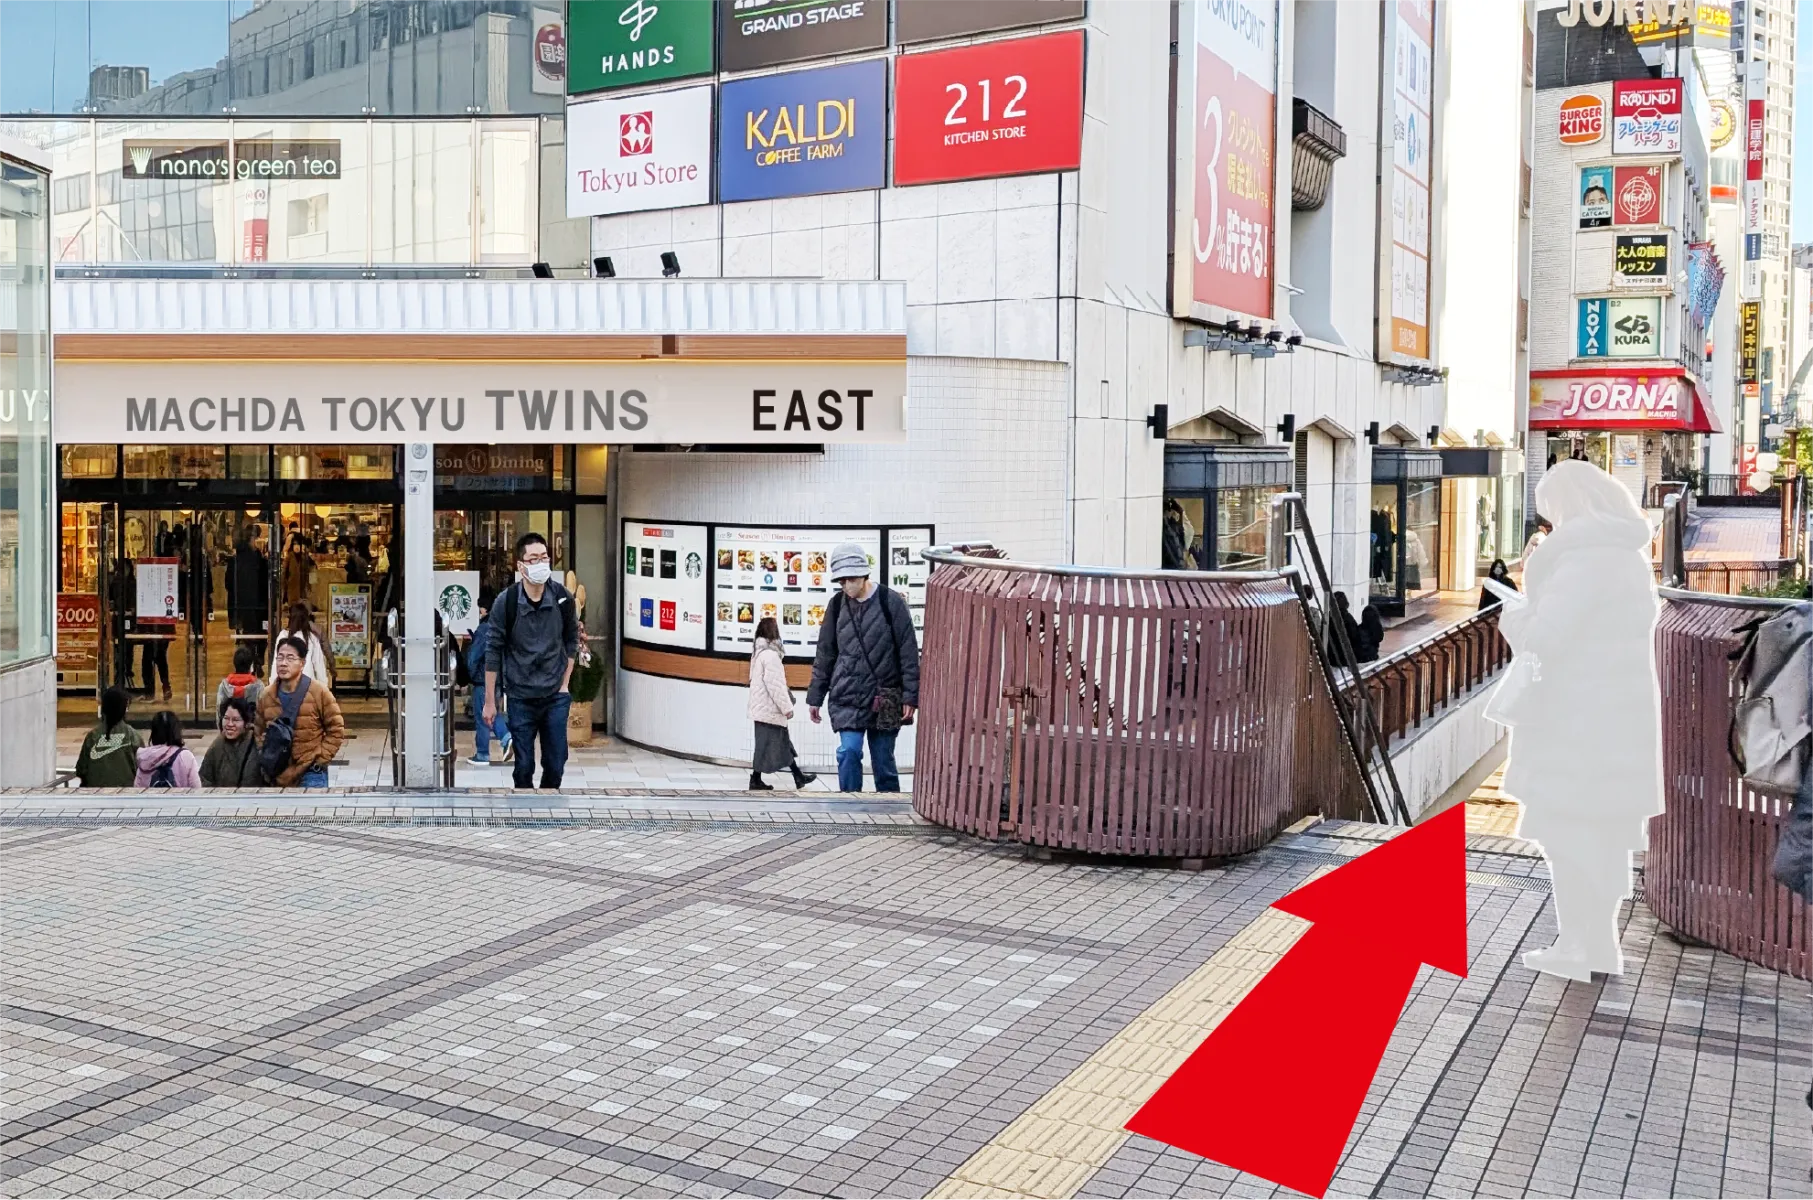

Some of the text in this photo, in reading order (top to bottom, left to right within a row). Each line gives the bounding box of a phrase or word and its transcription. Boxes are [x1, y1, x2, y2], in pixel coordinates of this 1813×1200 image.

[741, 1, 864, 36] GRAND STAGE
[1239, 3, 1266, 51] POINT
[602, 46, 674, 73] HANDS
[944, 75, 1028, 126] 212
[746, 98, 855, 150] KALDI
[1560, 106, 1603, 121] BURGER
[944, 125, 1026, 146] KITCHEN STORE
[1560, 118, 1602, 136] KING
[756, 142, 843, 167] COFFEE FARM
[236, 158, 297, 180] green
[303, 155, 338, 176] tea
[578, 162, 698, 194] Tokyu Store
[1647, 167, 1660, 177] 4F
[1617, 245, 1666, 258] 大人の音楽
[1617, 261, 1656, 272] レッスン
[1585, 300, 1600, 348] NOVA
[1614, 315, 1650, 334] くら
[1614, 335, 1650, 345] KURA
[126, 389, 873, 432] MACHDA TOKYU TWINS EAST
[1562, 384, 1677, 416] JORNA
[490, 456, 545, 473] Dining
